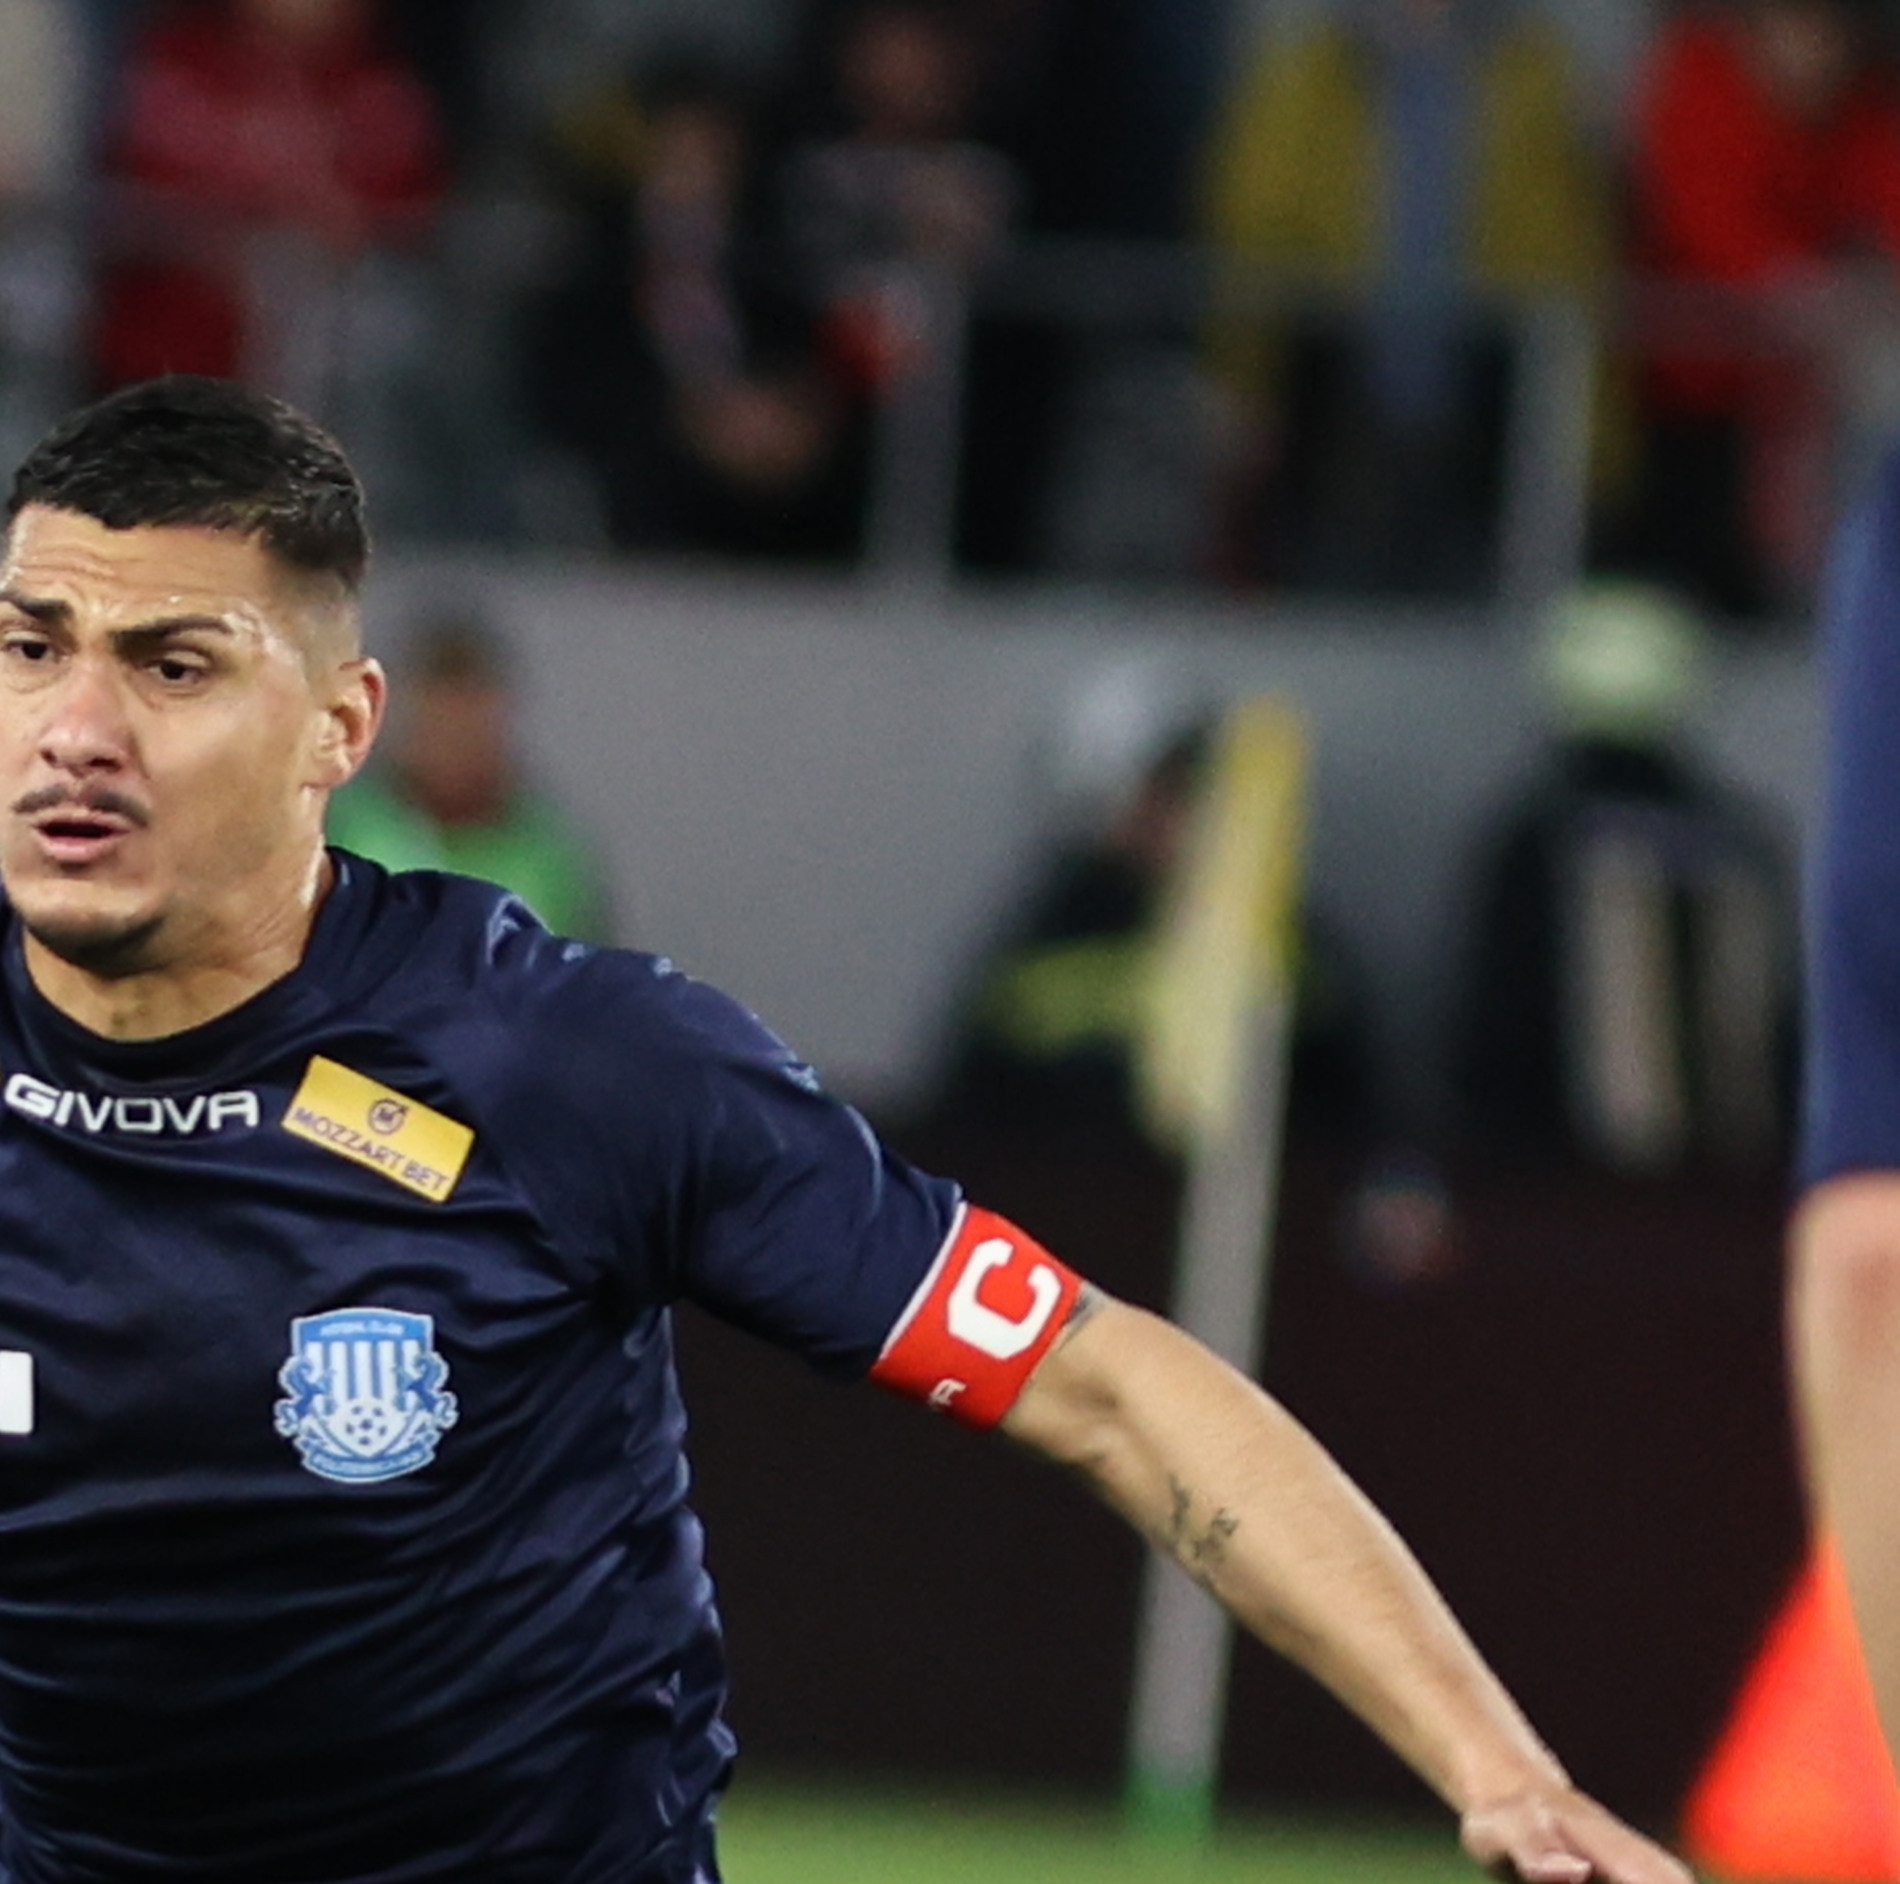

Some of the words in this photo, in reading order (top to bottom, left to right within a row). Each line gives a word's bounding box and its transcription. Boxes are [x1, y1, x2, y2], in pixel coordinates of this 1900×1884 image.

[3, 1072, 260, 1134] GIVOVA
[293, 1106, 406, 1171] MOZZART
[401, 1159, 451, 1191] BET
[946, 1236, 1063, 1362] C
